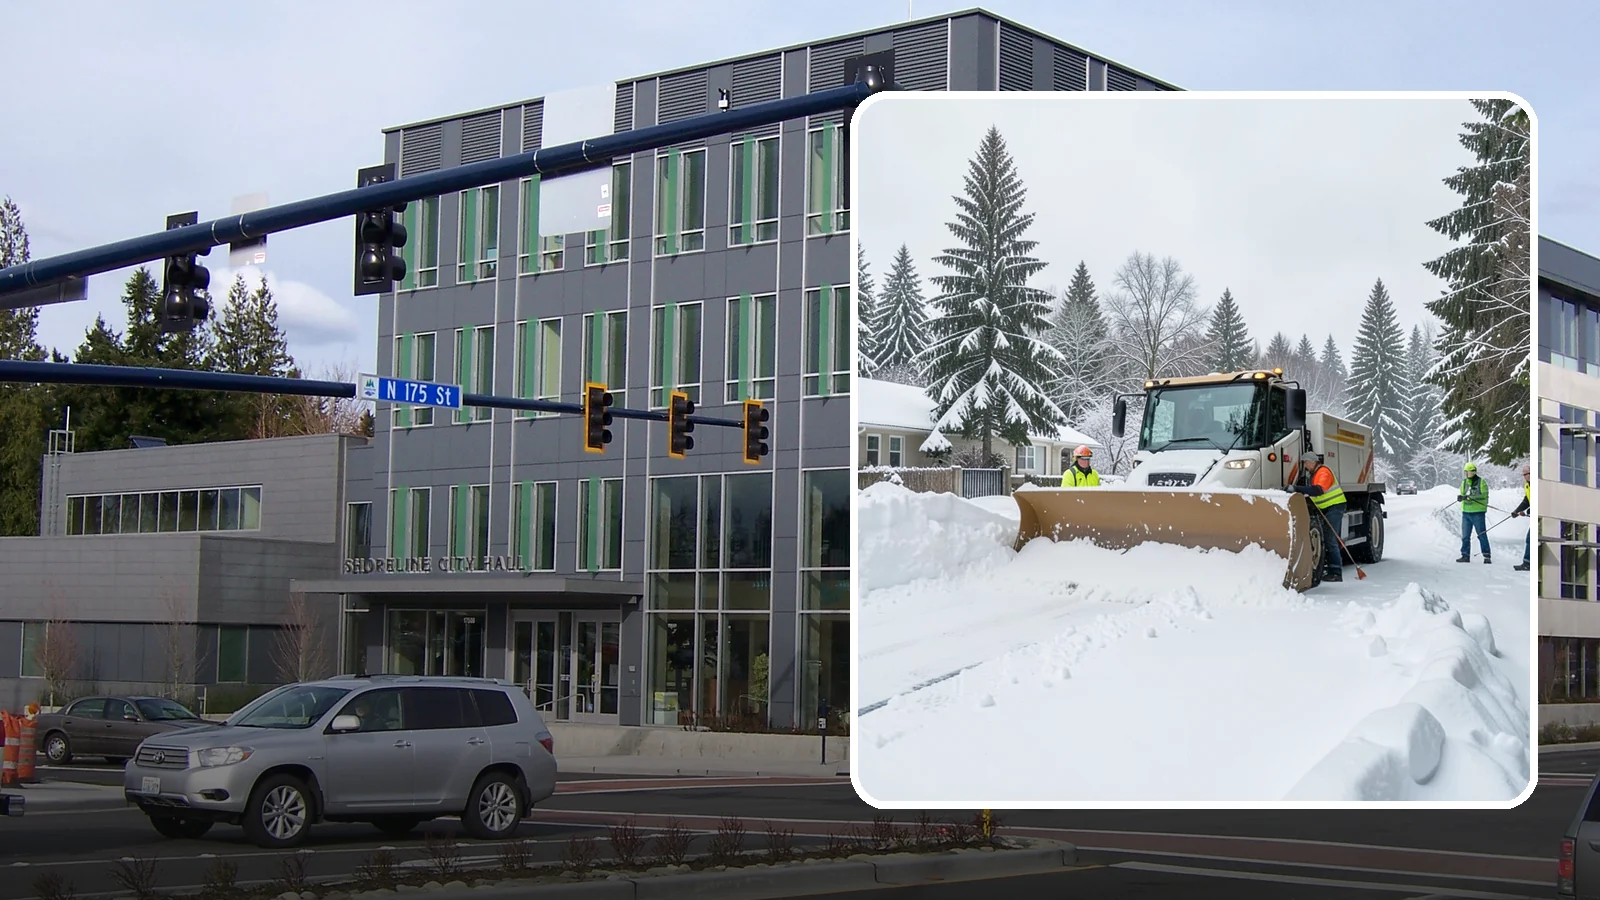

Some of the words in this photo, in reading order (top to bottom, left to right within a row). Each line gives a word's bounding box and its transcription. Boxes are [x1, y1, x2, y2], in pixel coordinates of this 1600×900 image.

[387, 380, 396, 399] N
[405, 383, 427, 403] 175
[436, 386, 451, 406] St
[345, 557, 432, 574] SHORELINE
[438, 556, 475, 573] CITY
[483, 555, 524, 571] HALL
